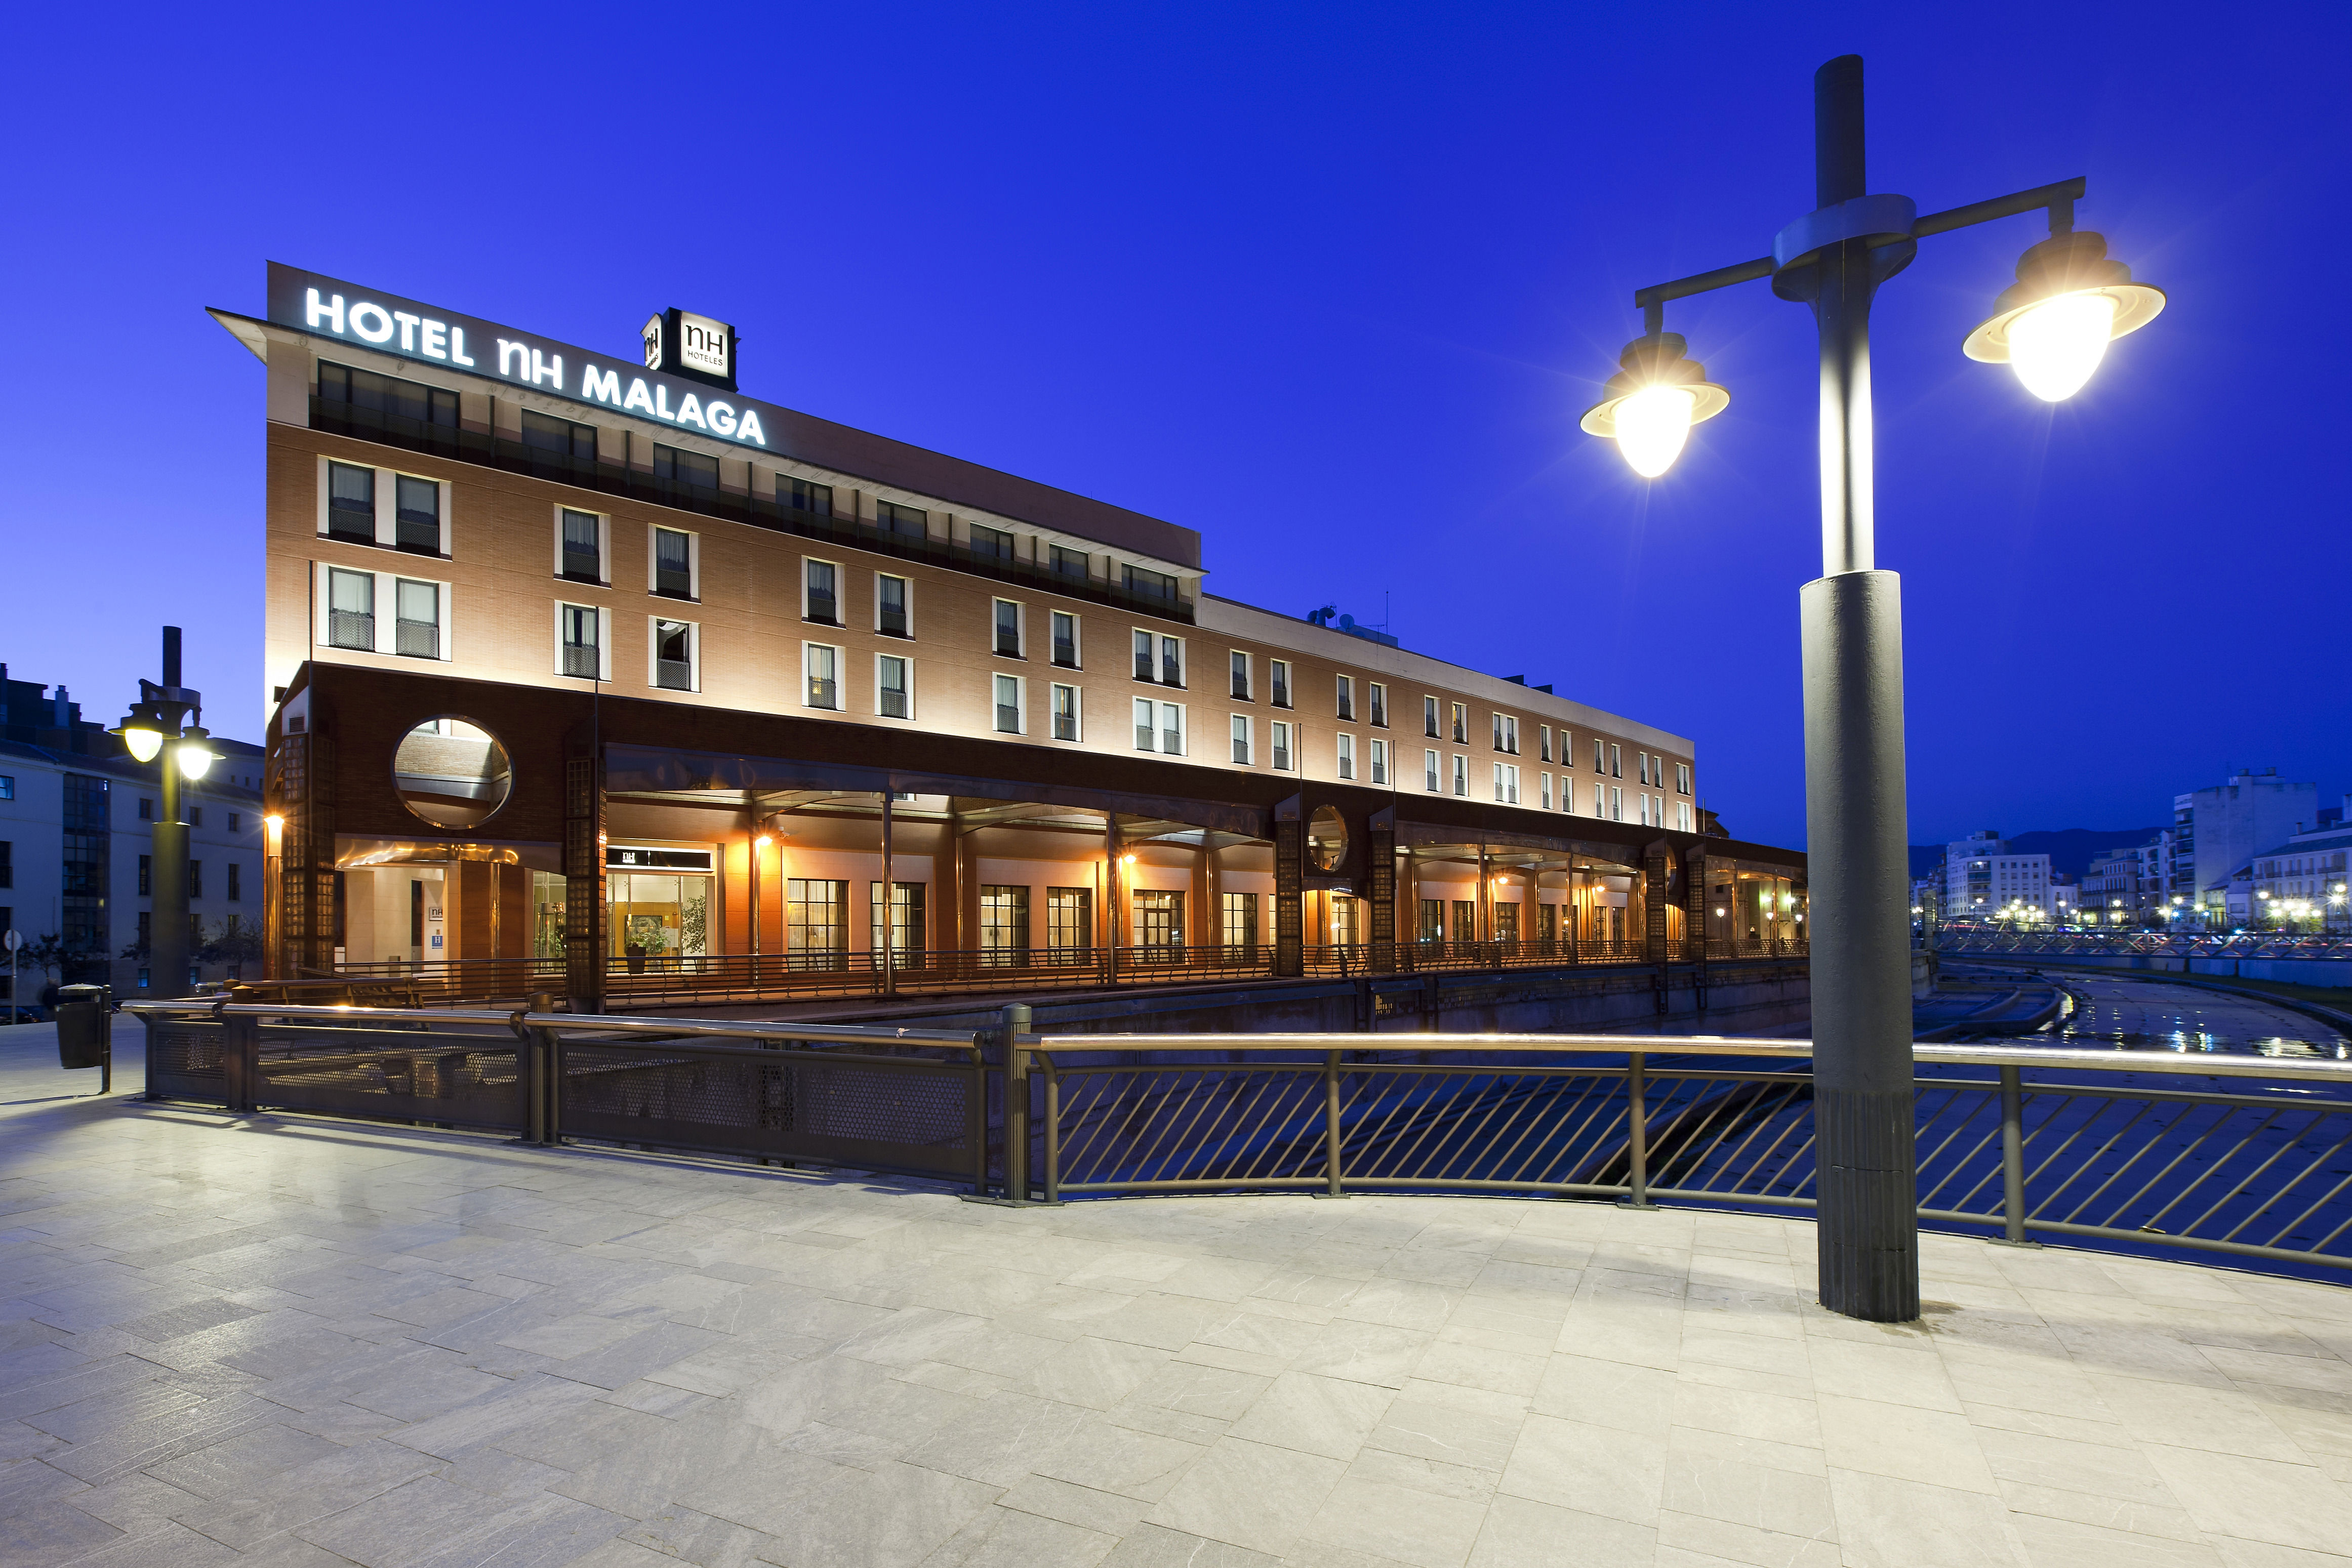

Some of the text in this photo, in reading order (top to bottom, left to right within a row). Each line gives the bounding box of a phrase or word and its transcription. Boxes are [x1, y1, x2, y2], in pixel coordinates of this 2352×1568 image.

[306, 287, 474, 366] HOTEL
[582, 364, 765, 445] MALAGA
[687, 350, 723, 366] HOTELES
